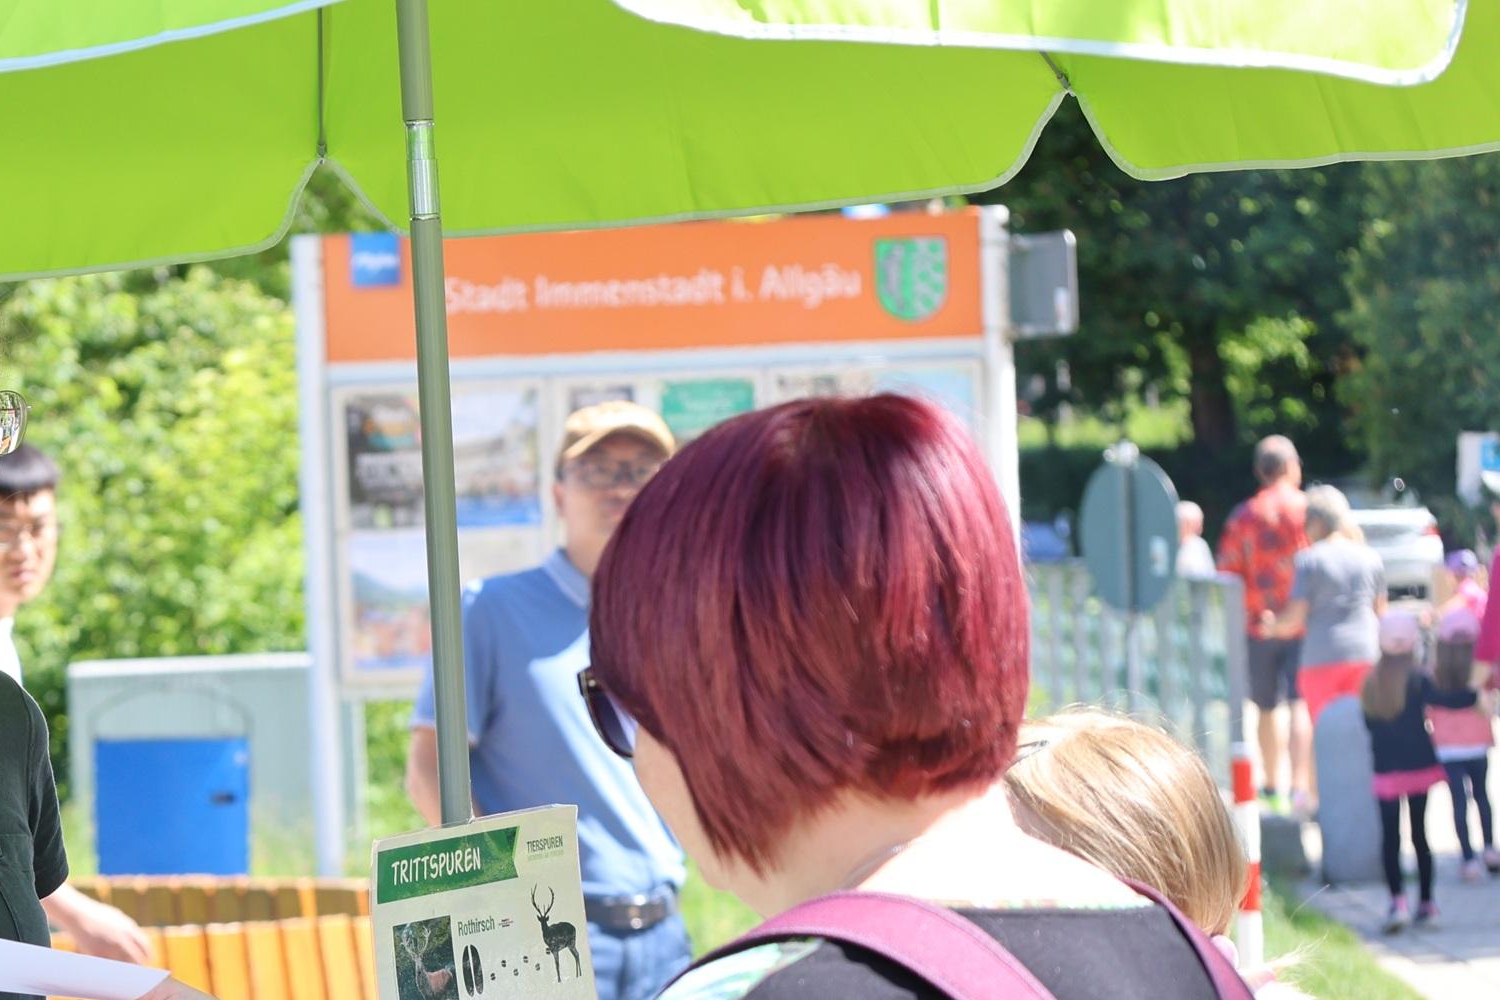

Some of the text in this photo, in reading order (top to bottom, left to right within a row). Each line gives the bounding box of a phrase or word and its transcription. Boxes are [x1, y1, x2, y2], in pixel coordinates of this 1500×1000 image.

[445, 274, 528, 315] Stadt
[535, 266, 724, 312] Immenstadt
[759, 262, 863, 310] Allgäu
[526, 835, 564, 853] TIERSPUREN
[391, 846, 482, 886] TRITTSPUREN
[457, 915, 495, 937] Rothirsch
